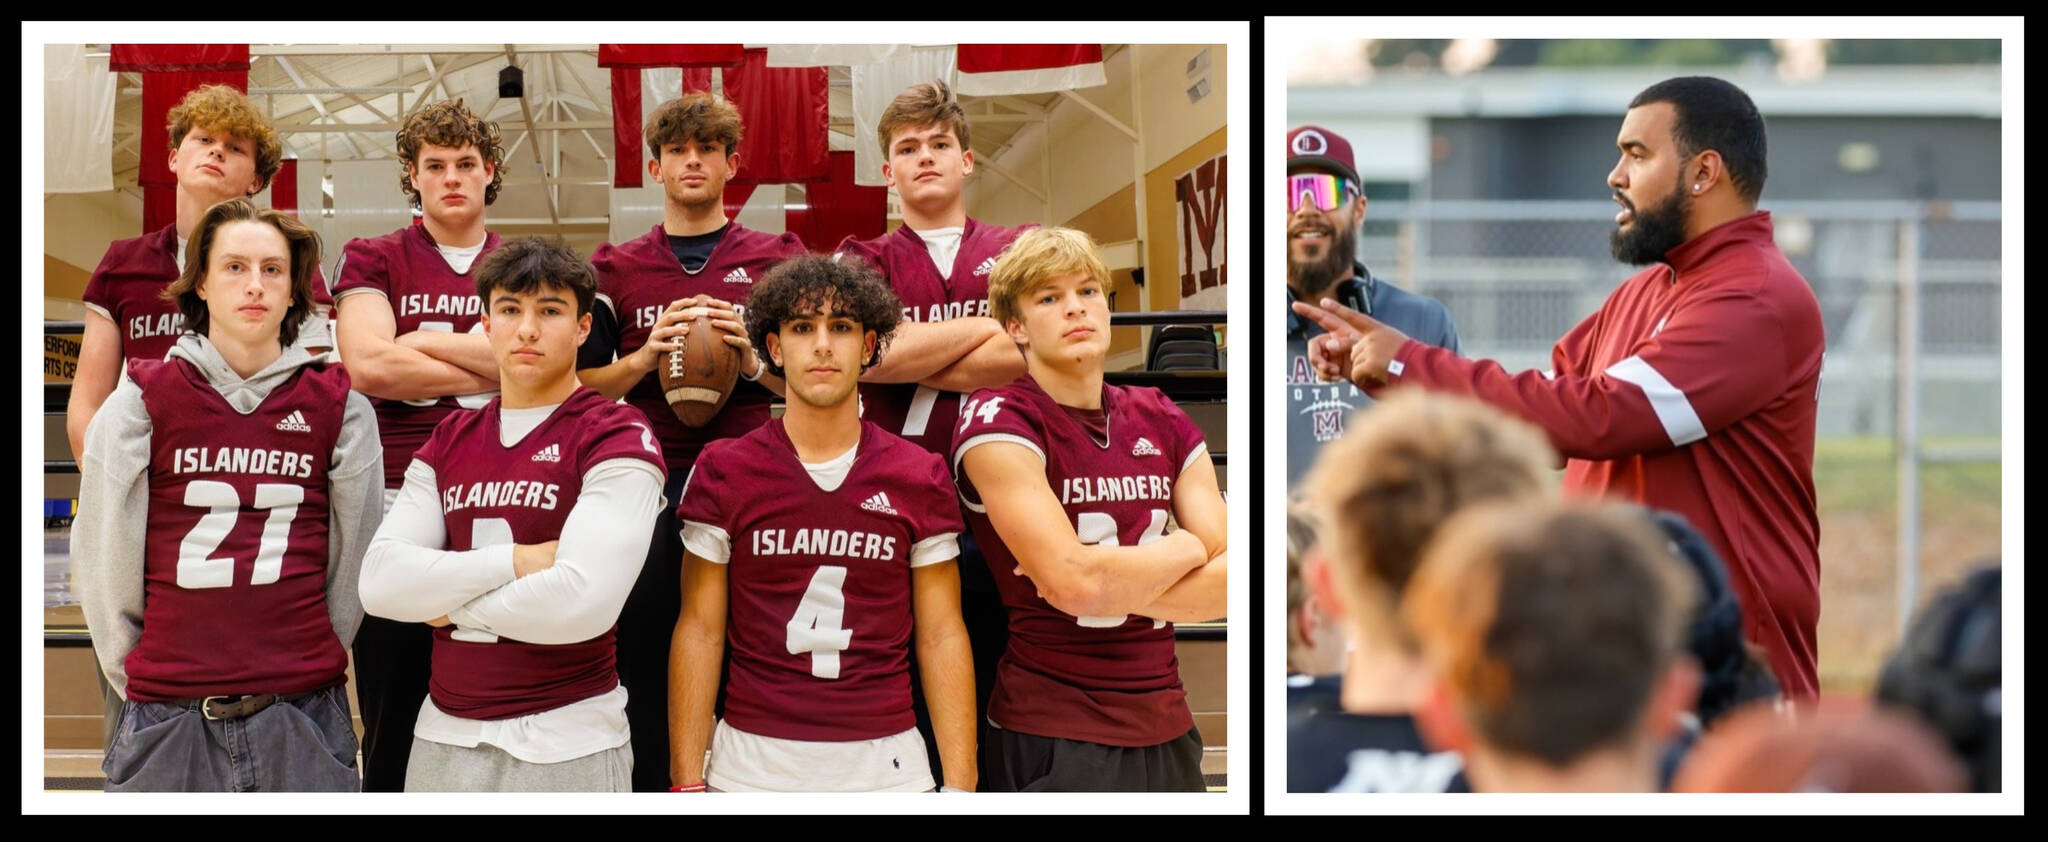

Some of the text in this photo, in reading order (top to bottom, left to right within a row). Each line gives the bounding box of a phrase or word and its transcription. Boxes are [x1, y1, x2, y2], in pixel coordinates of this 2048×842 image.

[400, 294, 485, 317] ISLAND
[901, 299, 991, 323] SLANDER
[129, 313, 185, 340] ISLAN
[44, 335, 82, 358] ERFORM
[63, 361, 77, 379] CE
[276, 422, 311, 433] adidas
[174, 447, 314, 478] ISLANDERS
[1132, 447, 1162, 456] adidas
[443, 481, 560, 515] ISLANDERS
[1062, 475, 1171, 505] ISLANDERS
[860, 501, 898, 515] adidas
[176, 480, 305, 589] 27
[752, 528, 896, 561] ISLANDERS
[786, 565, 853, 679] 4
